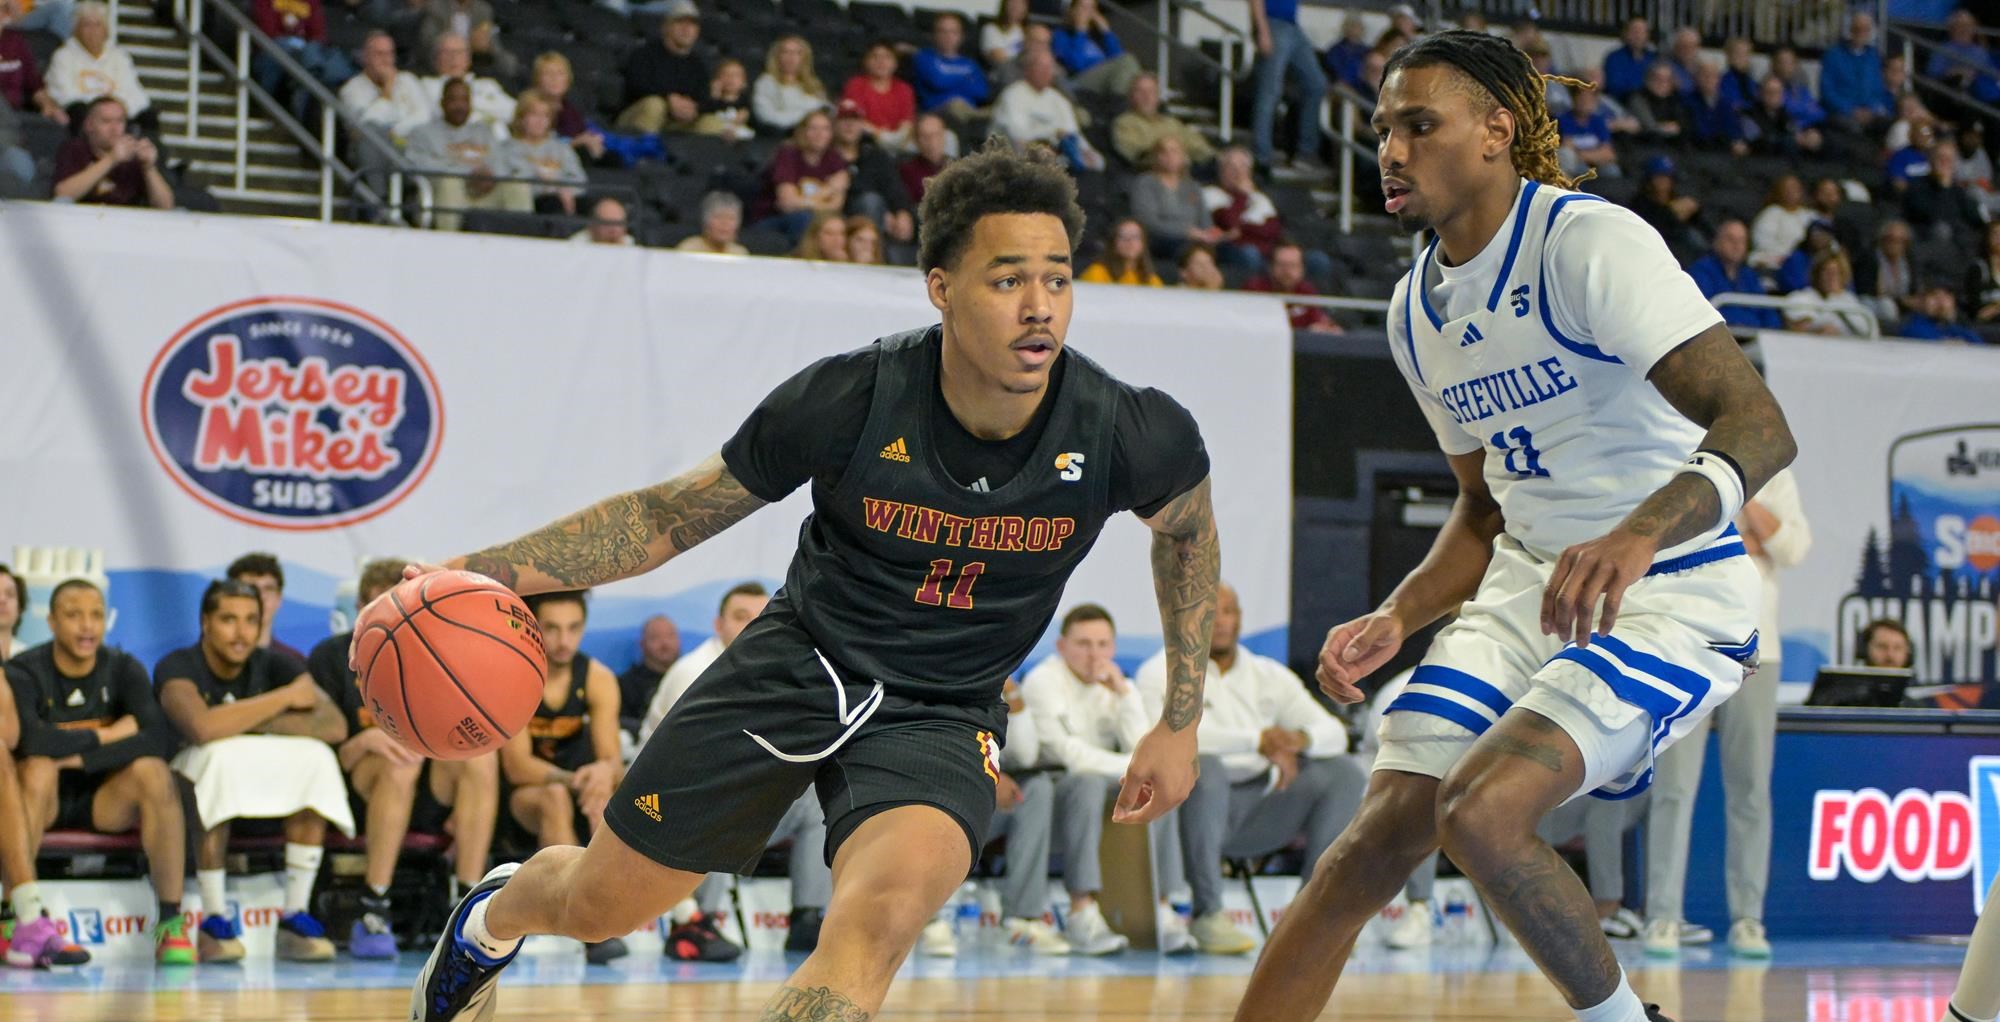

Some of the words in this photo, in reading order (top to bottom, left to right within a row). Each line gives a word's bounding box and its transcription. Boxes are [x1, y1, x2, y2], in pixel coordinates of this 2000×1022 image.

[250, 321, 301, 338] SINCE
[309, 324, 354, 347] 1956
[186, 338, 402, 430] Jersey
[1438, 356, 1578, 424] SHEVILLE
[196, 402, 398, 475] Mike's
[880, 449, 911, 463] adidas
[1491, 425, 1550, 477] 11
[252, 478, 333, 511] SUBS
[863, 497, 1075, 552] WINTHROP
[915, 559, 985, 609] 11
[1841, 598, 1996, 684] CAMP
[634, 798, 662, 822] adidas
[1812, 792, 1973, 877] FOOD
[104, 914, 146, 934] CITY
